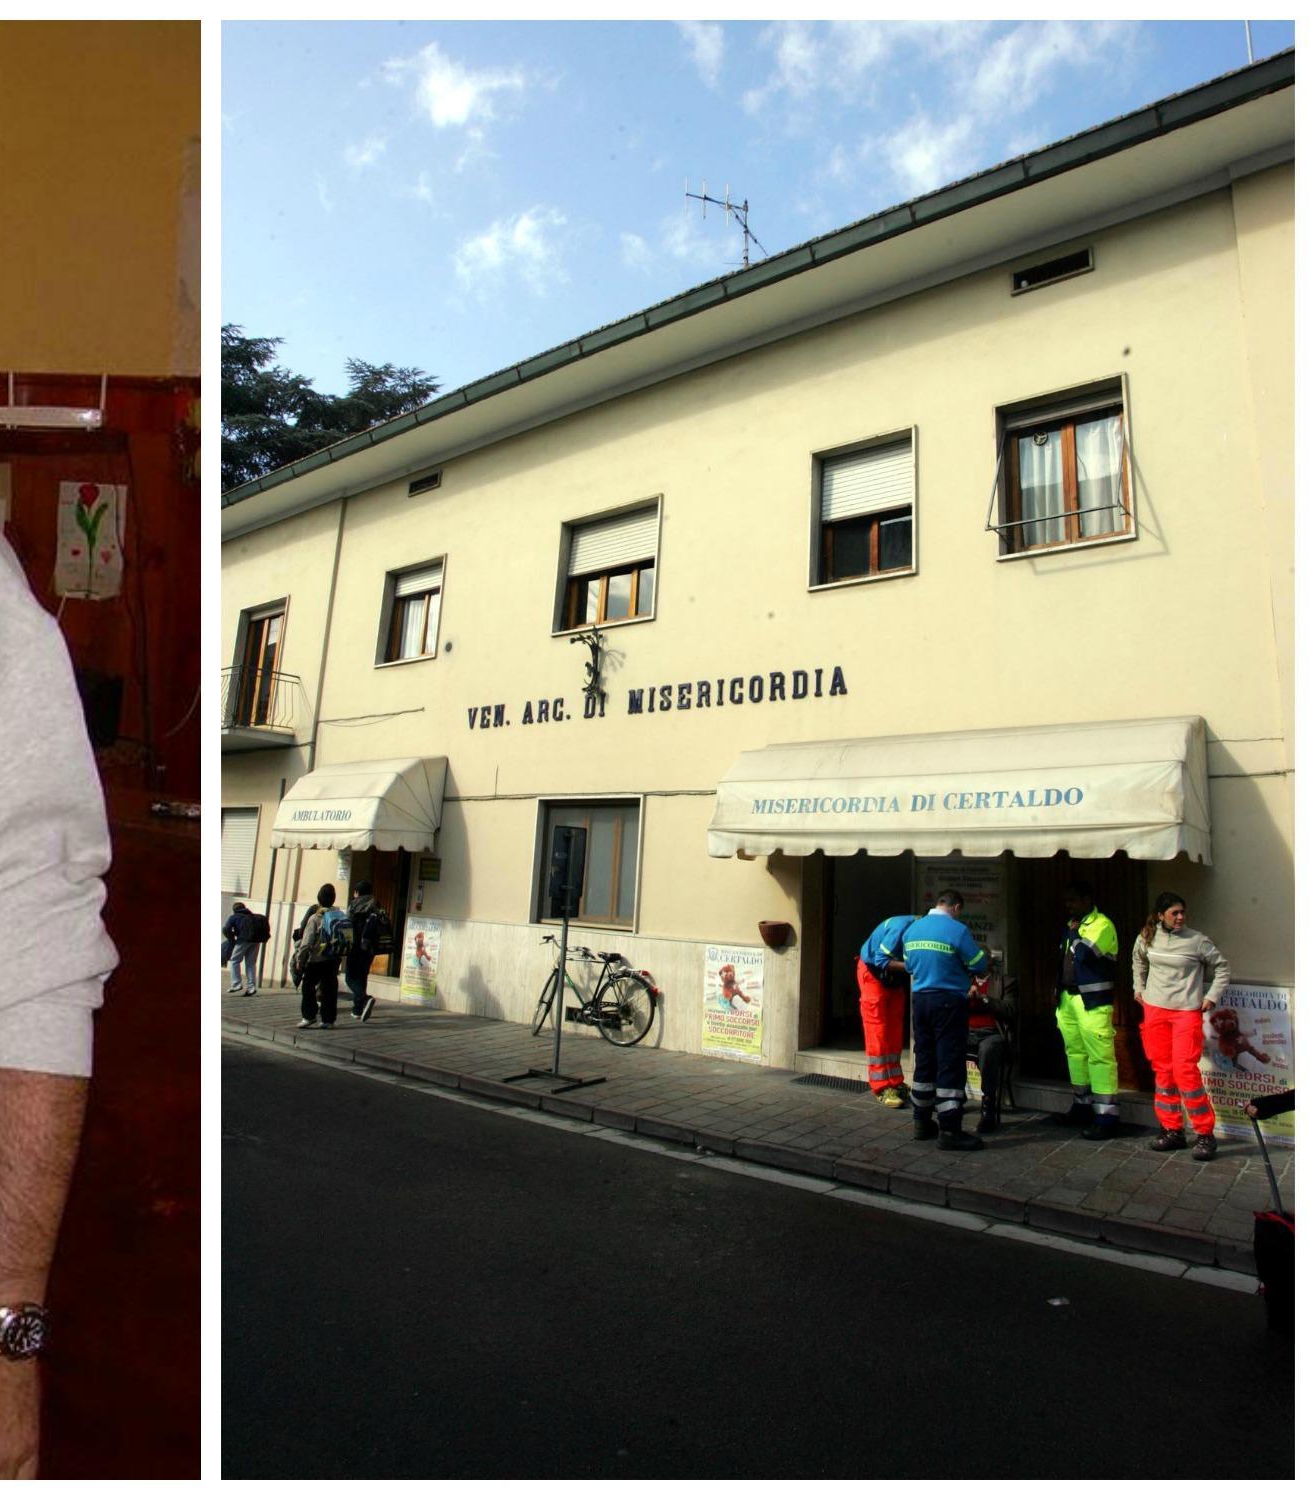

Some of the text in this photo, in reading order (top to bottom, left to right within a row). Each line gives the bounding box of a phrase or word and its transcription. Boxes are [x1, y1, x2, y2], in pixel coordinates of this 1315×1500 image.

[467, 665, 848, 730] VEN. ARC. DI MISERICORDIA
[751, 786, 1084, 815] MISERICORDIA DI CERTALDO
[293, 809, 352, 822] AMBULATORIO
[1225, 988, 1273, 999] ERICORDIA
[1219, 995, 1288, 1011] ERTALDO
[1203, 1076, 1225, 1088] IMO
[1235, 1071, 1276, 1084] CORSI
